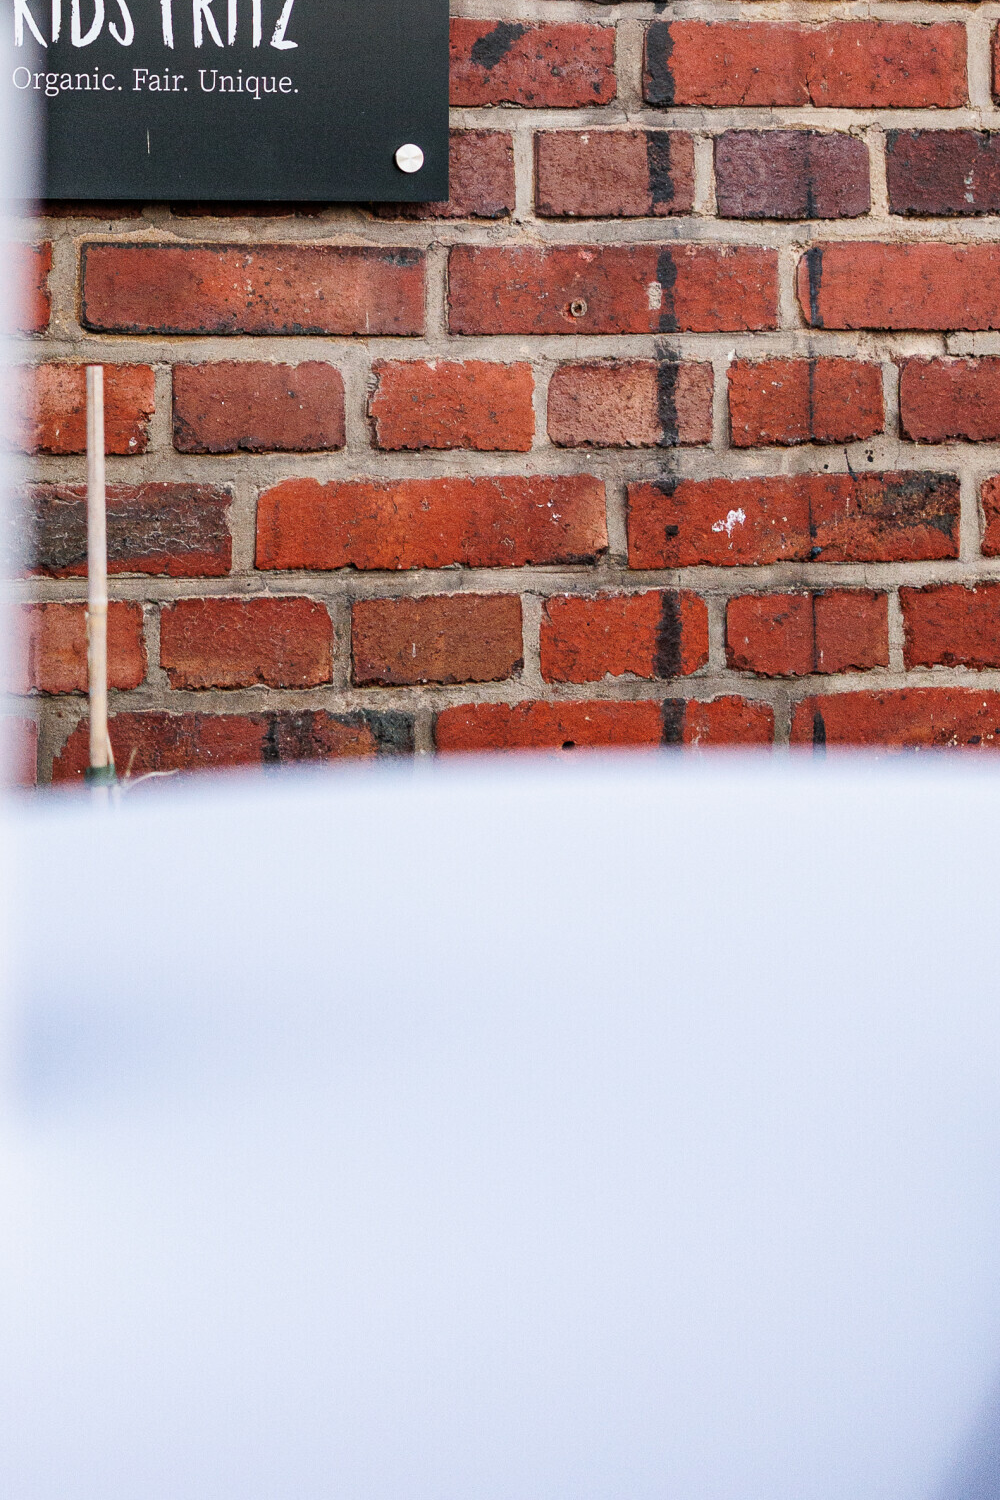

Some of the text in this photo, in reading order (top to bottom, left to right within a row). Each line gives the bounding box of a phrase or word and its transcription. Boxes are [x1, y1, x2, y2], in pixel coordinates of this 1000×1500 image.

[12, 66, 300, 100] Organic. Fair. Unique.
